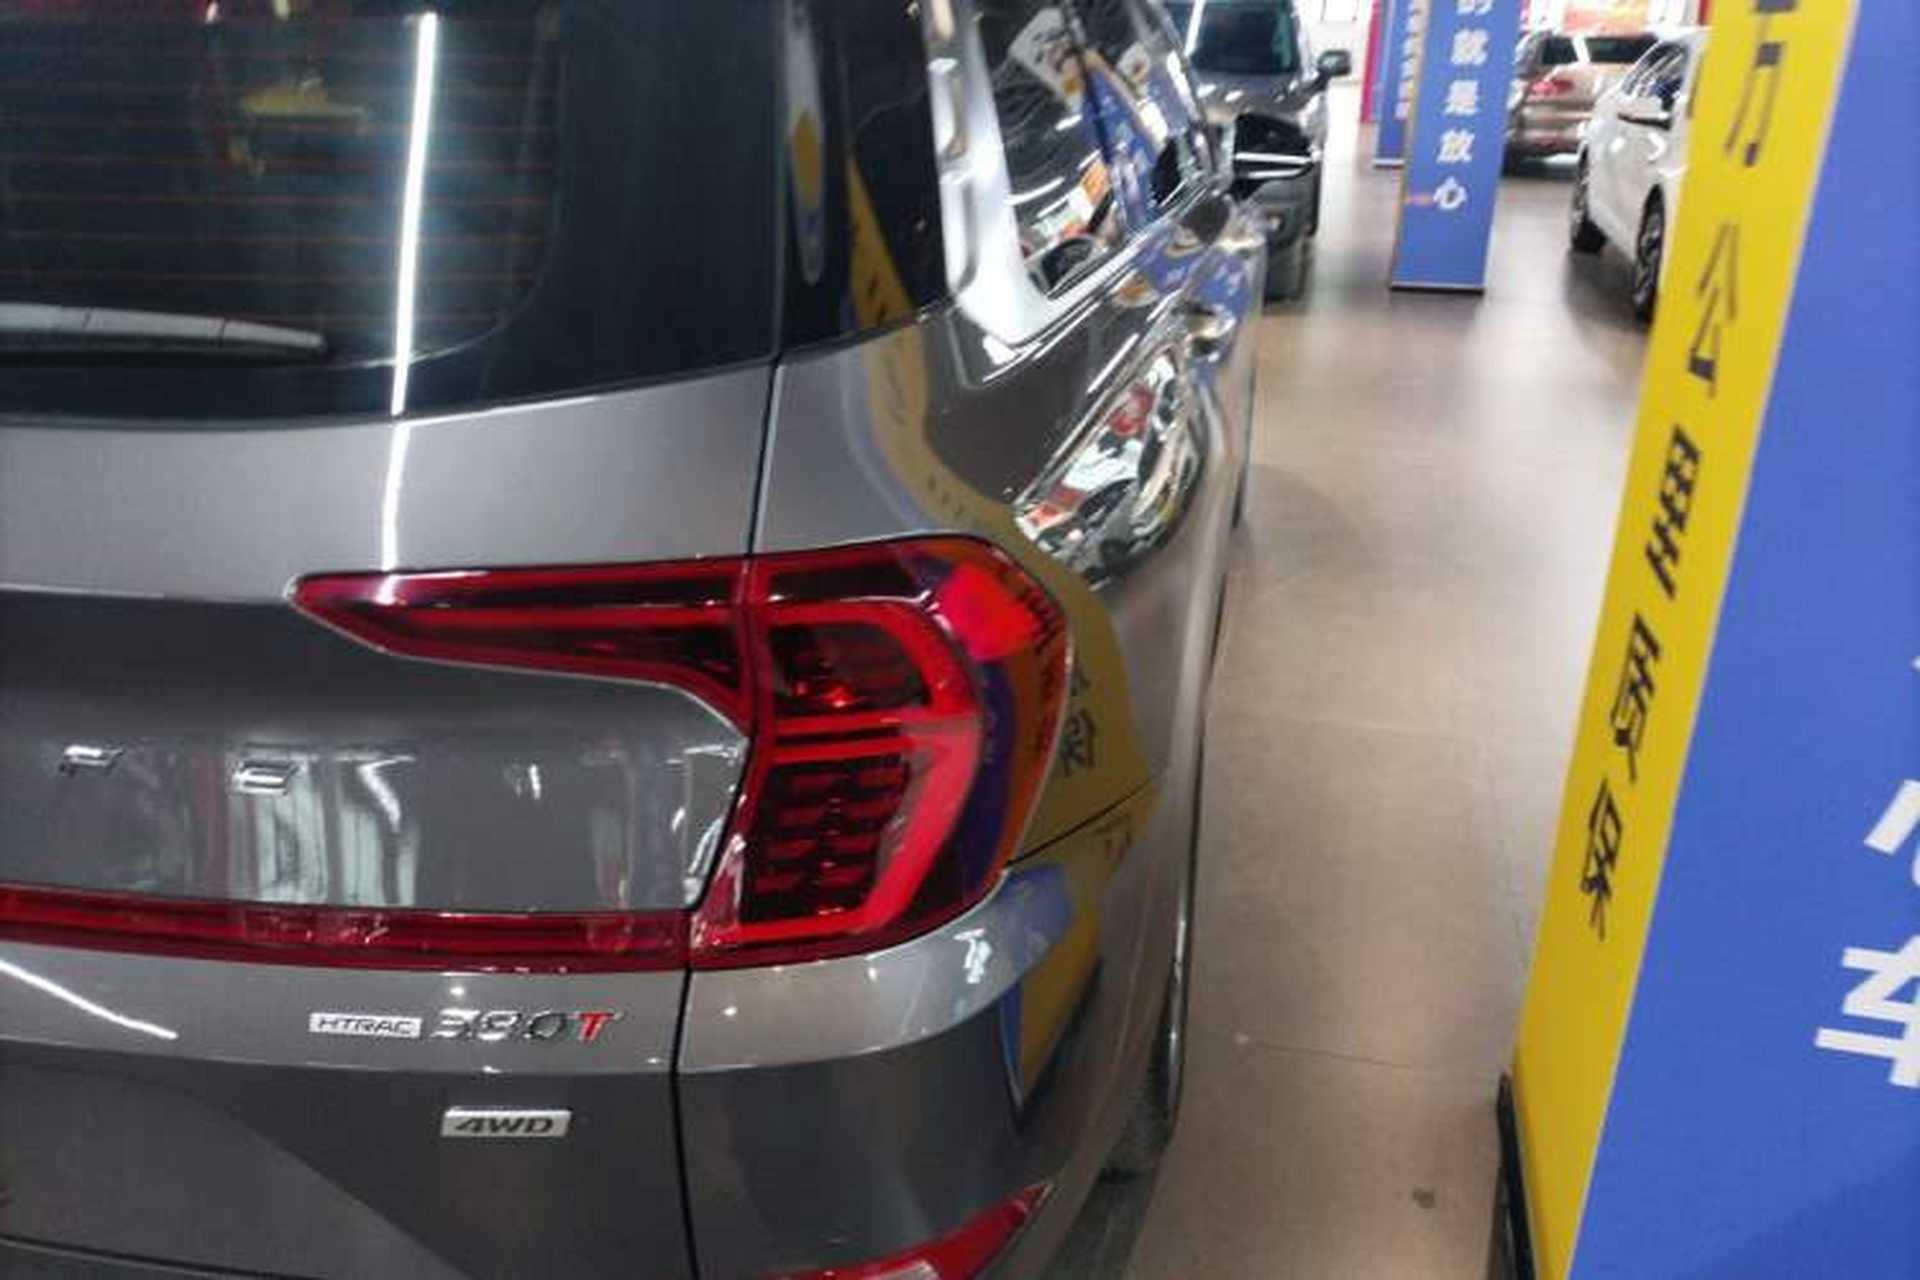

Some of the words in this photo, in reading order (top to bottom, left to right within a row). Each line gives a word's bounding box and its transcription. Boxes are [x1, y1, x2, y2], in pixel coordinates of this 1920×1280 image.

[312, 1015, 418, 1037] HTRAC
[430, 1008, 622, 1040] 380T
[452, 1114, 558, 1135] 4WD
